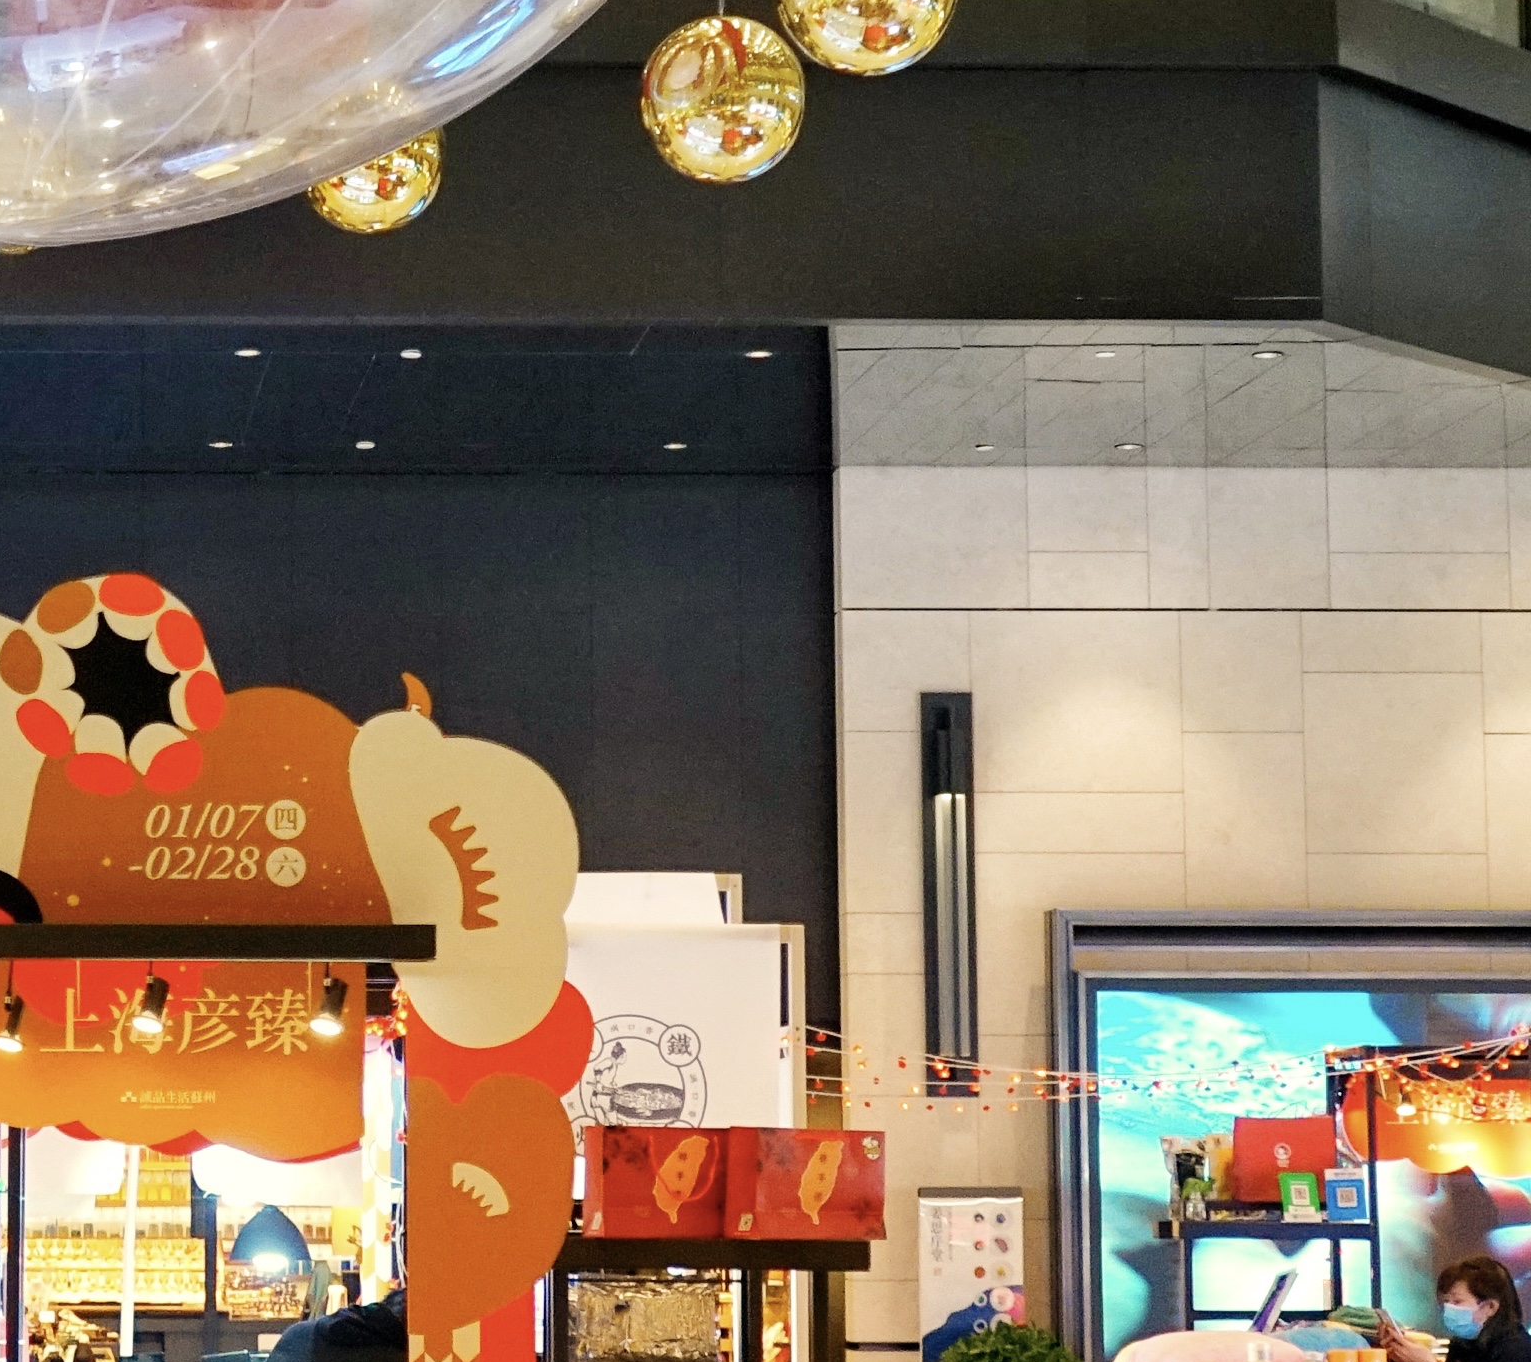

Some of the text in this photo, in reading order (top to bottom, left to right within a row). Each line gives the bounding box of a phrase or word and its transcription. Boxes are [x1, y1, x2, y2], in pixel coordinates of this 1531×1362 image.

[144, 802, 298, 841] 01/07 四
[128, 845, 299, 882] -02/28 六
[39, 987, 309, 1056] 上海彦臻
[139, 1090, 217, 1104] 誠品生活蘇州
